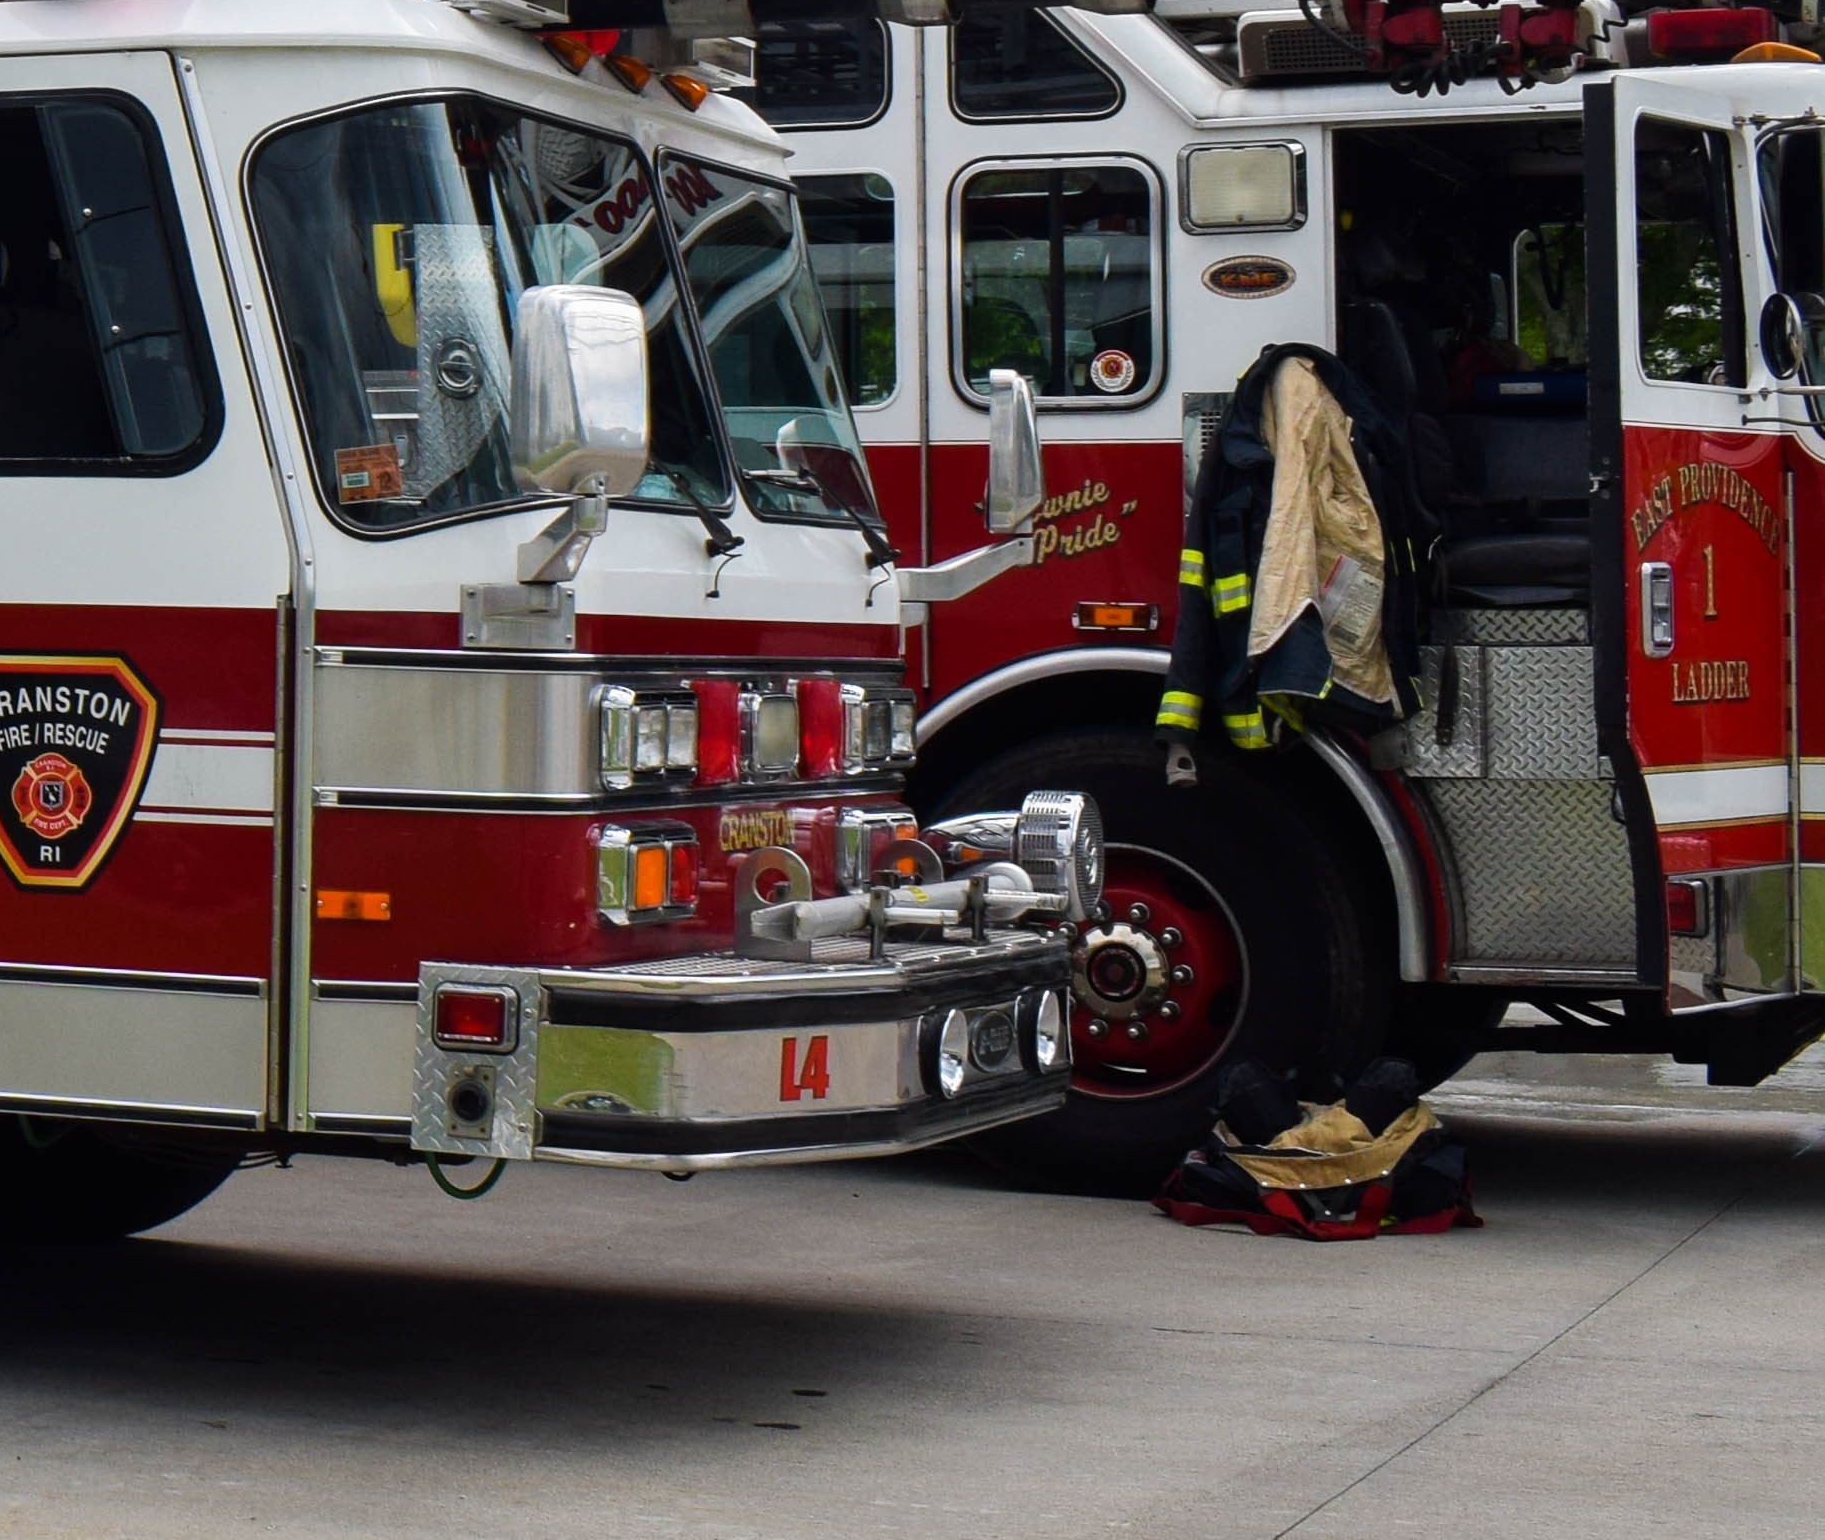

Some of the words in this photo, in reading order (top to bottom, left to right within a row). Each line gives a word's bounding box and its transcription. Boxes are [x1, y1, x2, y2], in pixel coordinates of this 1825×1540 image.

[1631, 476, 1673, 551] EAST
[1678, 461, 1782, 555] PROVIDENCE
[1703, 544, 1717, 620] 1
[1671, 661, 1749, 702] LADDER
[44, 723, 110, 755] RESCUE
[39, 844, 61, 863] RI
[780, 1035, 830, 1102] L4
